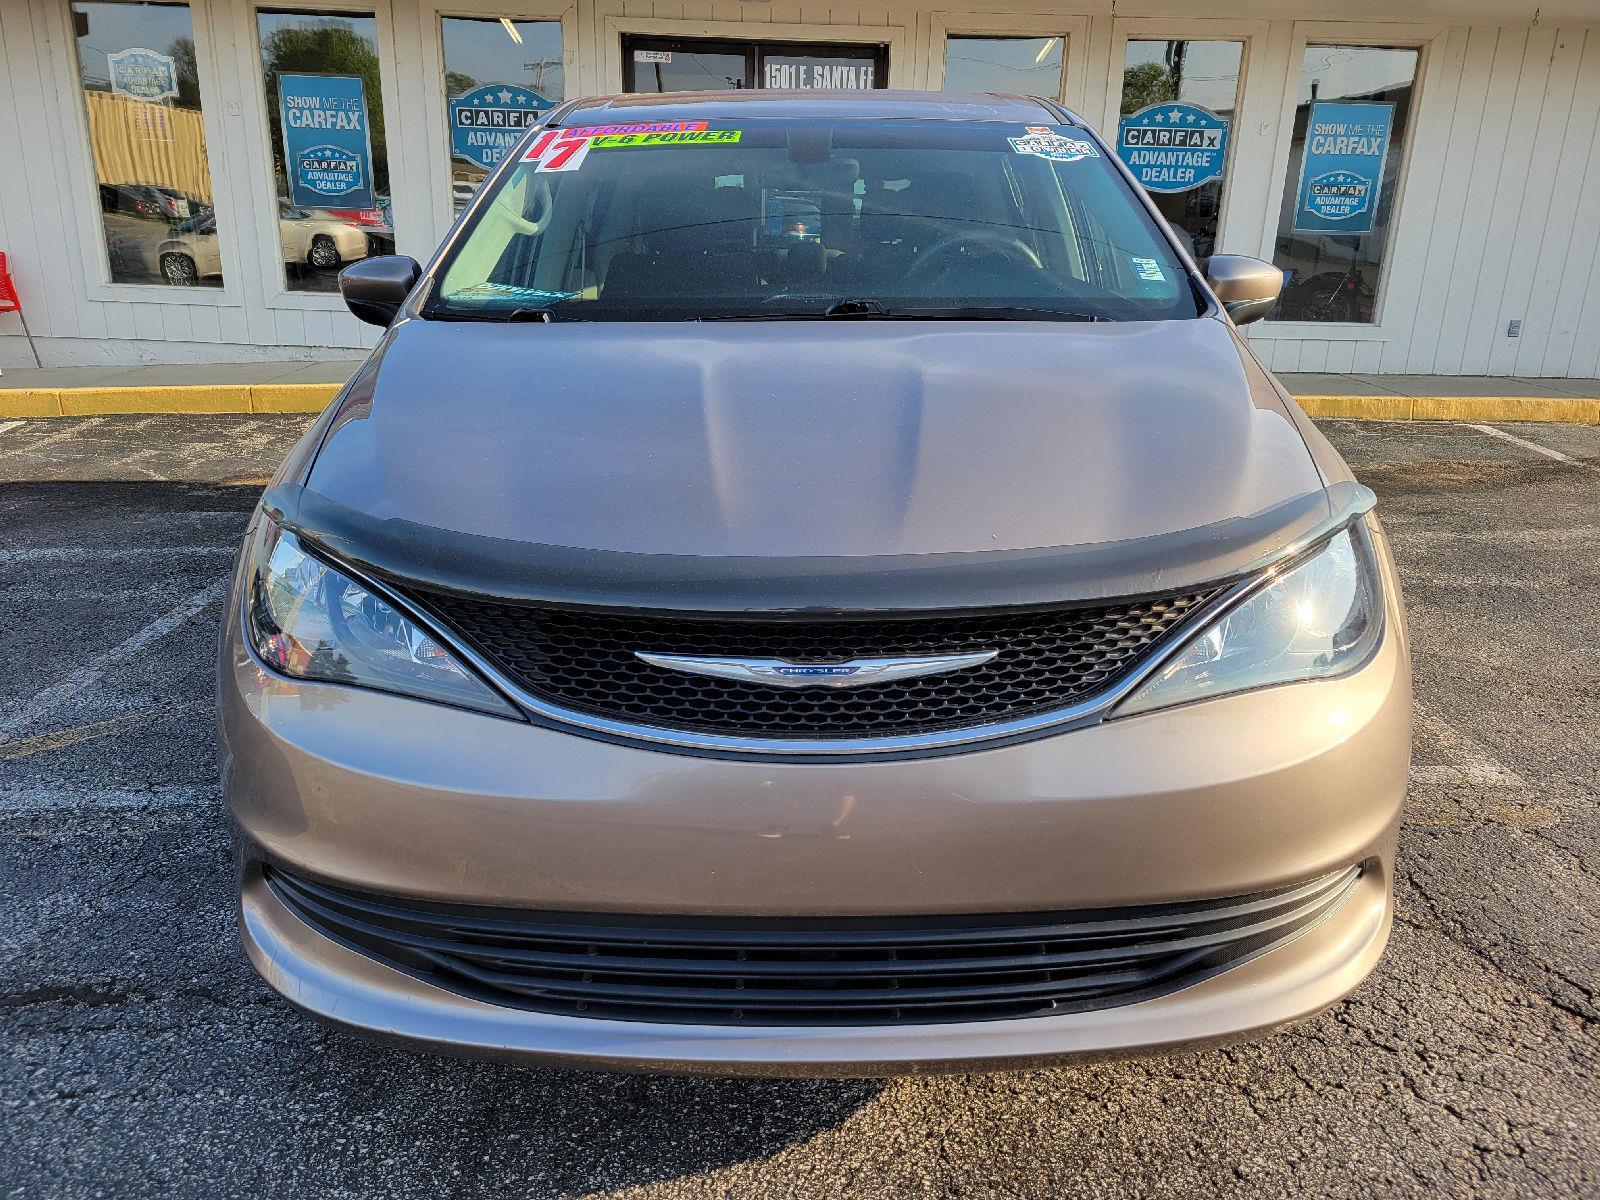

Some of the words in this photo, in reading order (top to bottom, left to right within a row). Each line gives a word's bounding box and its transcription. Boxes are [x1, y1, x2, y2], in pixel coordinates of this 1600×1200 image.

[765, 64, 796, 89] 1501
[799, 65, 811, 89] E.
[813, 65, 856, 90] SANTA
[860, 66, 874, 90] FE
[287, 96, 319, 108] SHOW
[323, 97, 338, 110] ME
[341, 98, 359, 111] THE
[288, 108, 361, 130] CARFAX
[460, 111, 539, 126] CARFA
[566, 123, 697, 137] AFFORDABLE
[1314, 123, 1347, 136] SHOW
[1348, 124, 1363, 136] ME
[1367, 124, 1385, 136] THE
[591, 135, 638, 146] V-6
[642, 130, 735, 143] POWER
[1126, 129, 1217, 148] CARFAX
[1311, 136, 1381, 156] CARFAX
[302, 160, 356, 171] CARFAX
[1129, 150, 1211, 167] ADVANTAGE
[307, 172, 353, 181] ADVANTAGE
[1141, 167, 1195, 182] DEALER
[316, 180, 346, 190] DEALER
[1313, 185, 1365, 196] CARFAX
[1315, 196, 1359, 206] ADVANTAGE
[1321, 205, 1350, 214] DEALER
